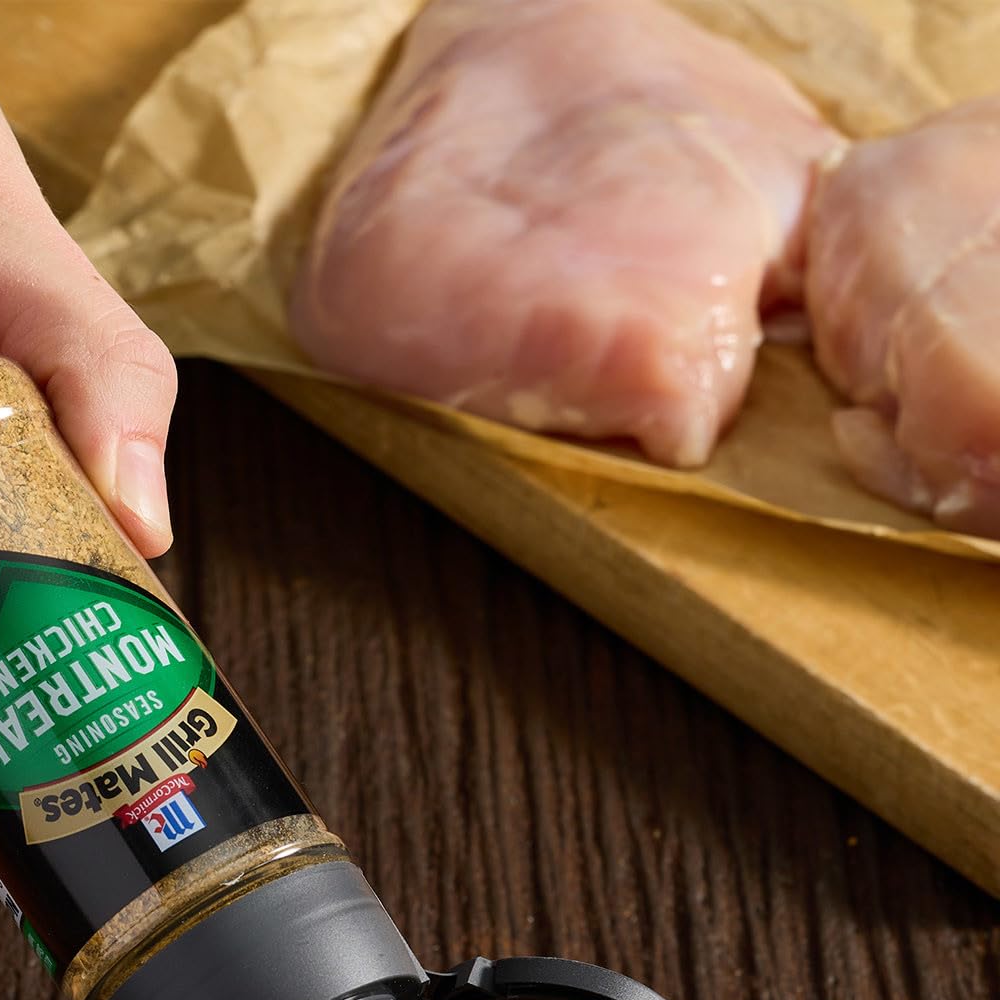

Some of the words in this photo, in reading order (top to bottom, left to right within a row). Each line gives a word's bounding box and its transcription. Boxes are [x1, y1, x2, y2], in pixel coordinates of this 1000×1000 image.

[53, 690, 164, 765] SEASONING
[151, 708, 218, 772] Grill
[125, 776, 190, 820] McCormick
